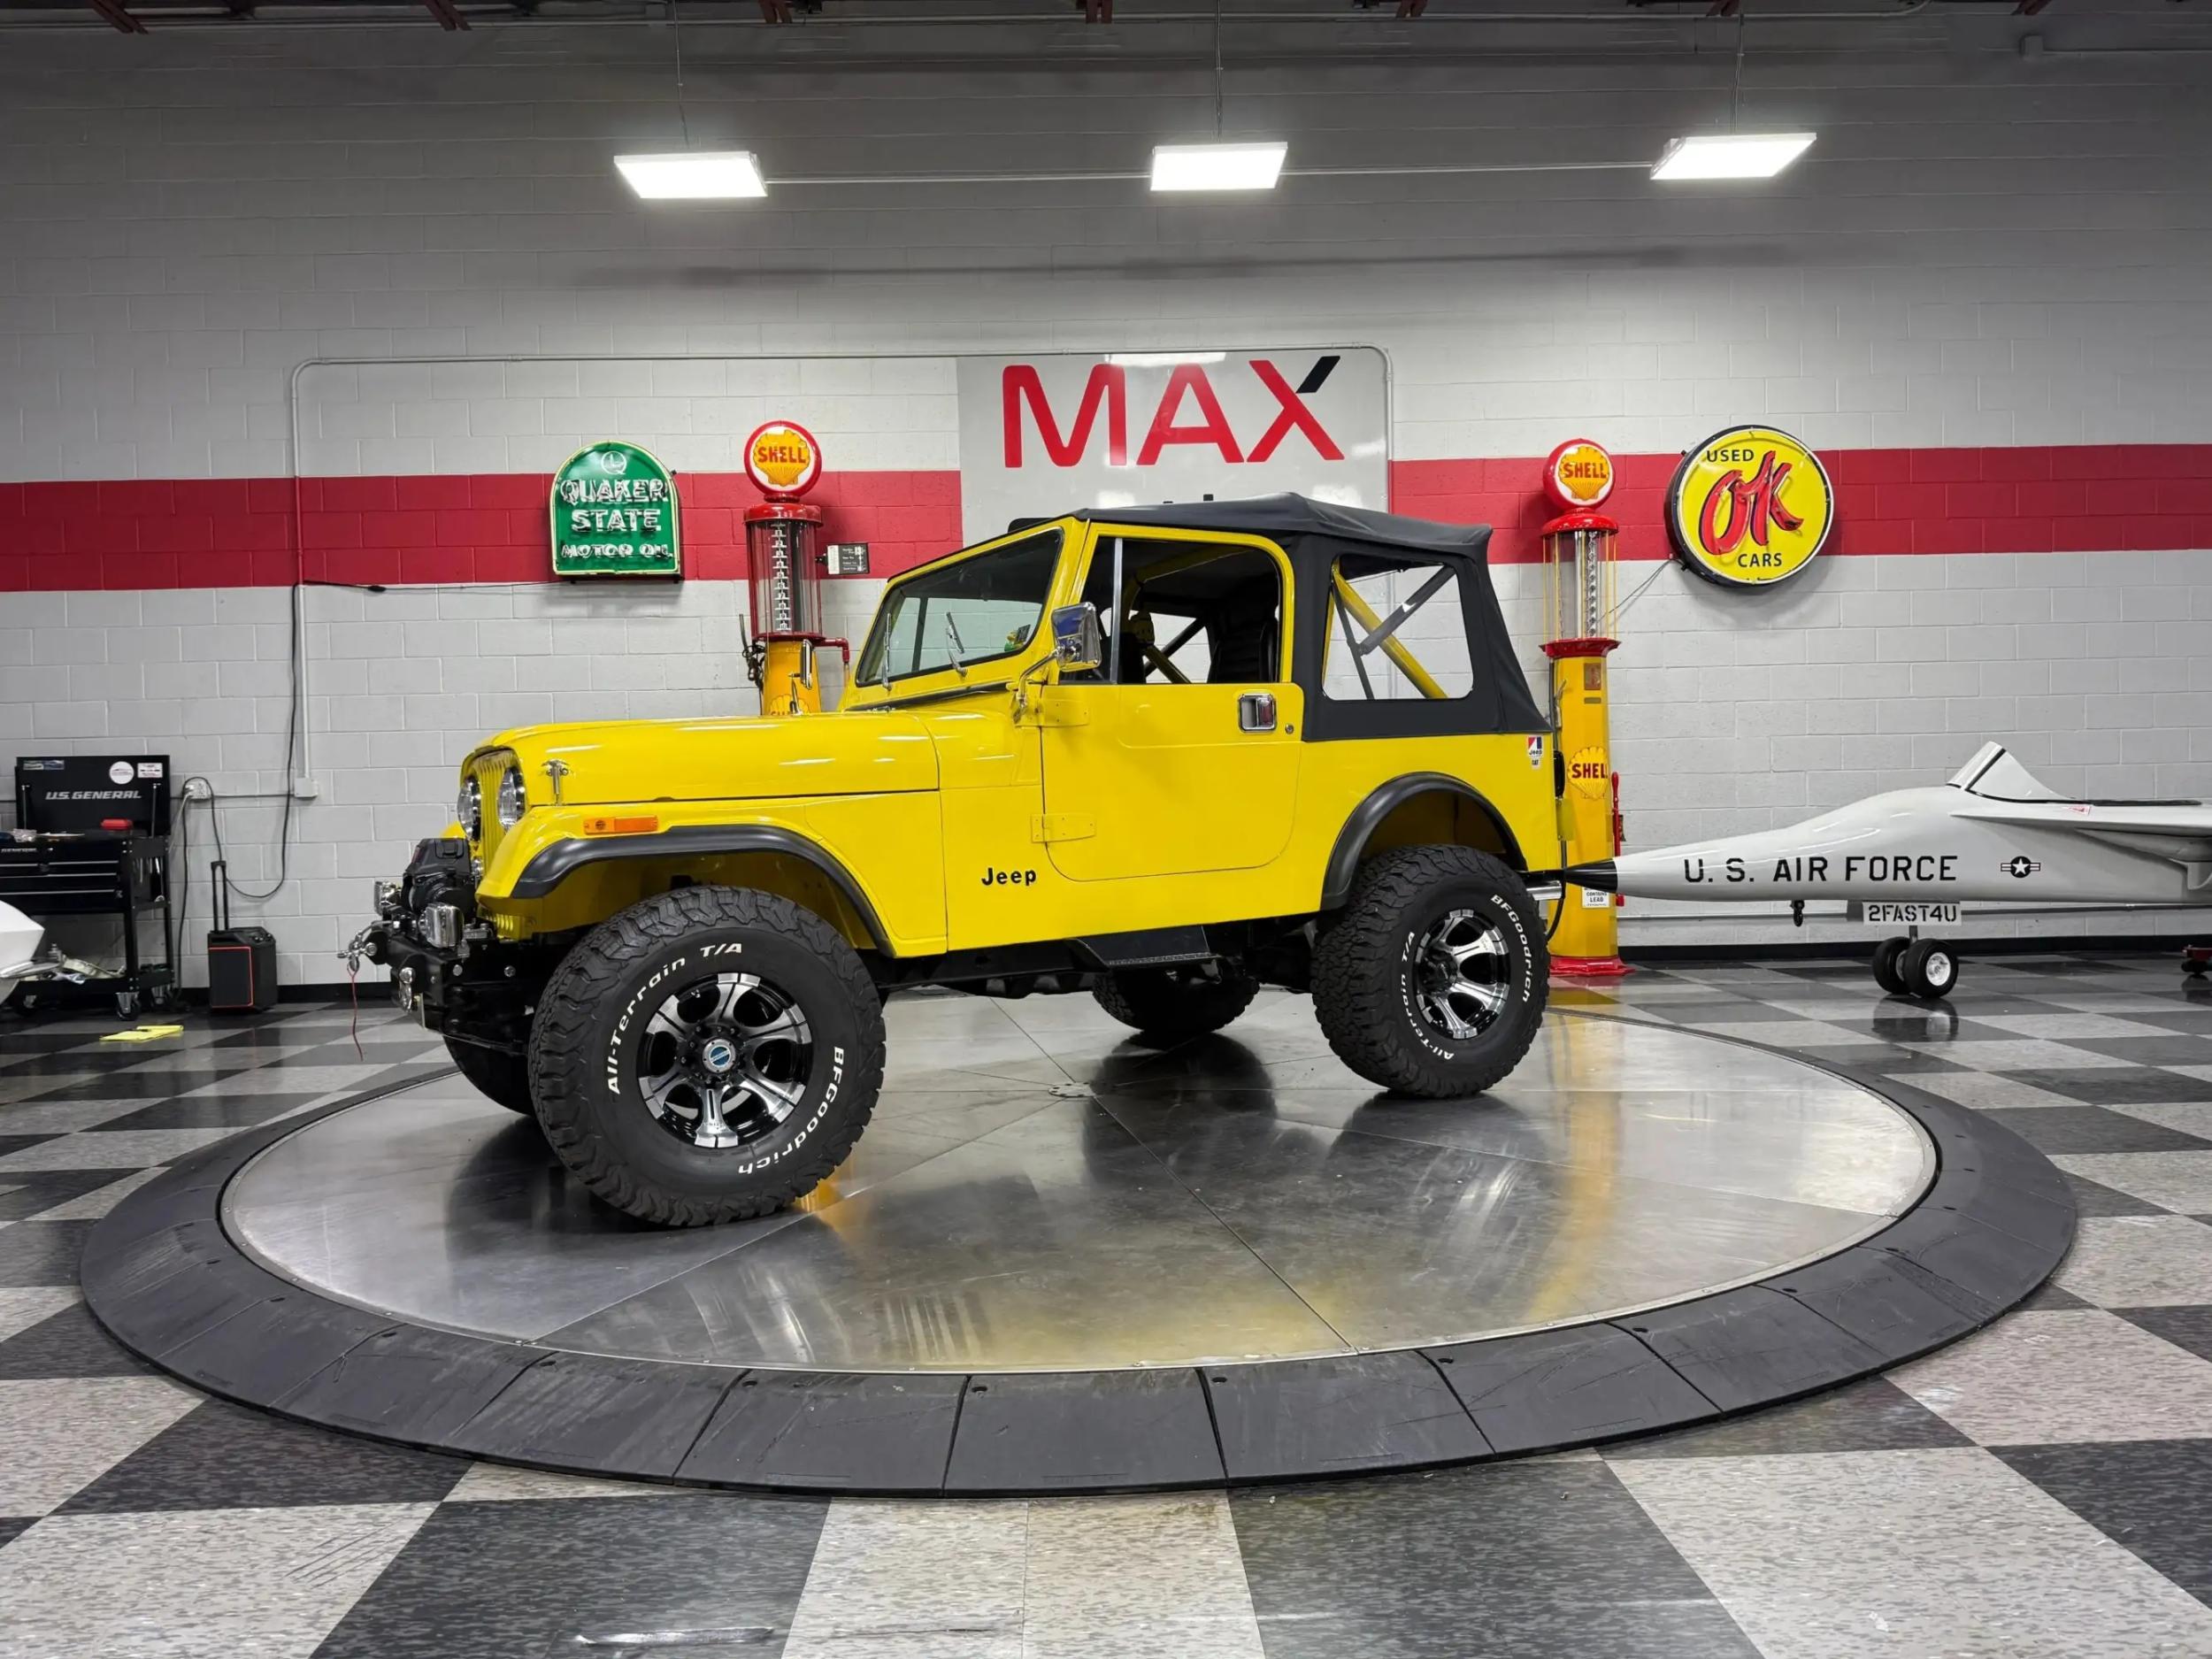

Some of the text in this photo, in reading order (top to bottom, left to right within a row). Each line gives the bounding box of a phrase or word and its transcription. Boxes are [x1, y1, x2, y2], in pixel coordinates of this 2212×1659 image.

[1002, 356, 1346, 468] MAX
[757, 445, 807, 465] SHELL
[1706, 449, 1755, 463] USED
[1563, 461, 1607, 479] SHELL
[560, 478, 669, 505] QUAKER
[1698, 449, 1804, 556] OK
[571, 509, 662, 532] STATE
[561, 543, 634, 558] MOTOR
[1737, 552, 1783, 567] CARS
[72, 790, 142, 800] GENERAL
[981, 867, 1037, 887] Jeep
[1772, 856, 1829, 882] AIR
[1845, 856, 1958, 882] FORCE
[1868, 903, 1958, 923] 2FAST4U
[1491, 894, 1532, 1002] BFGoodrich
[1401, 932, 1455, 1060] All-Terrain T/A
[607, 942, 743, 1095] All-Terrain T/A
[738, 1046, 845, 1176] BFGoodrich
